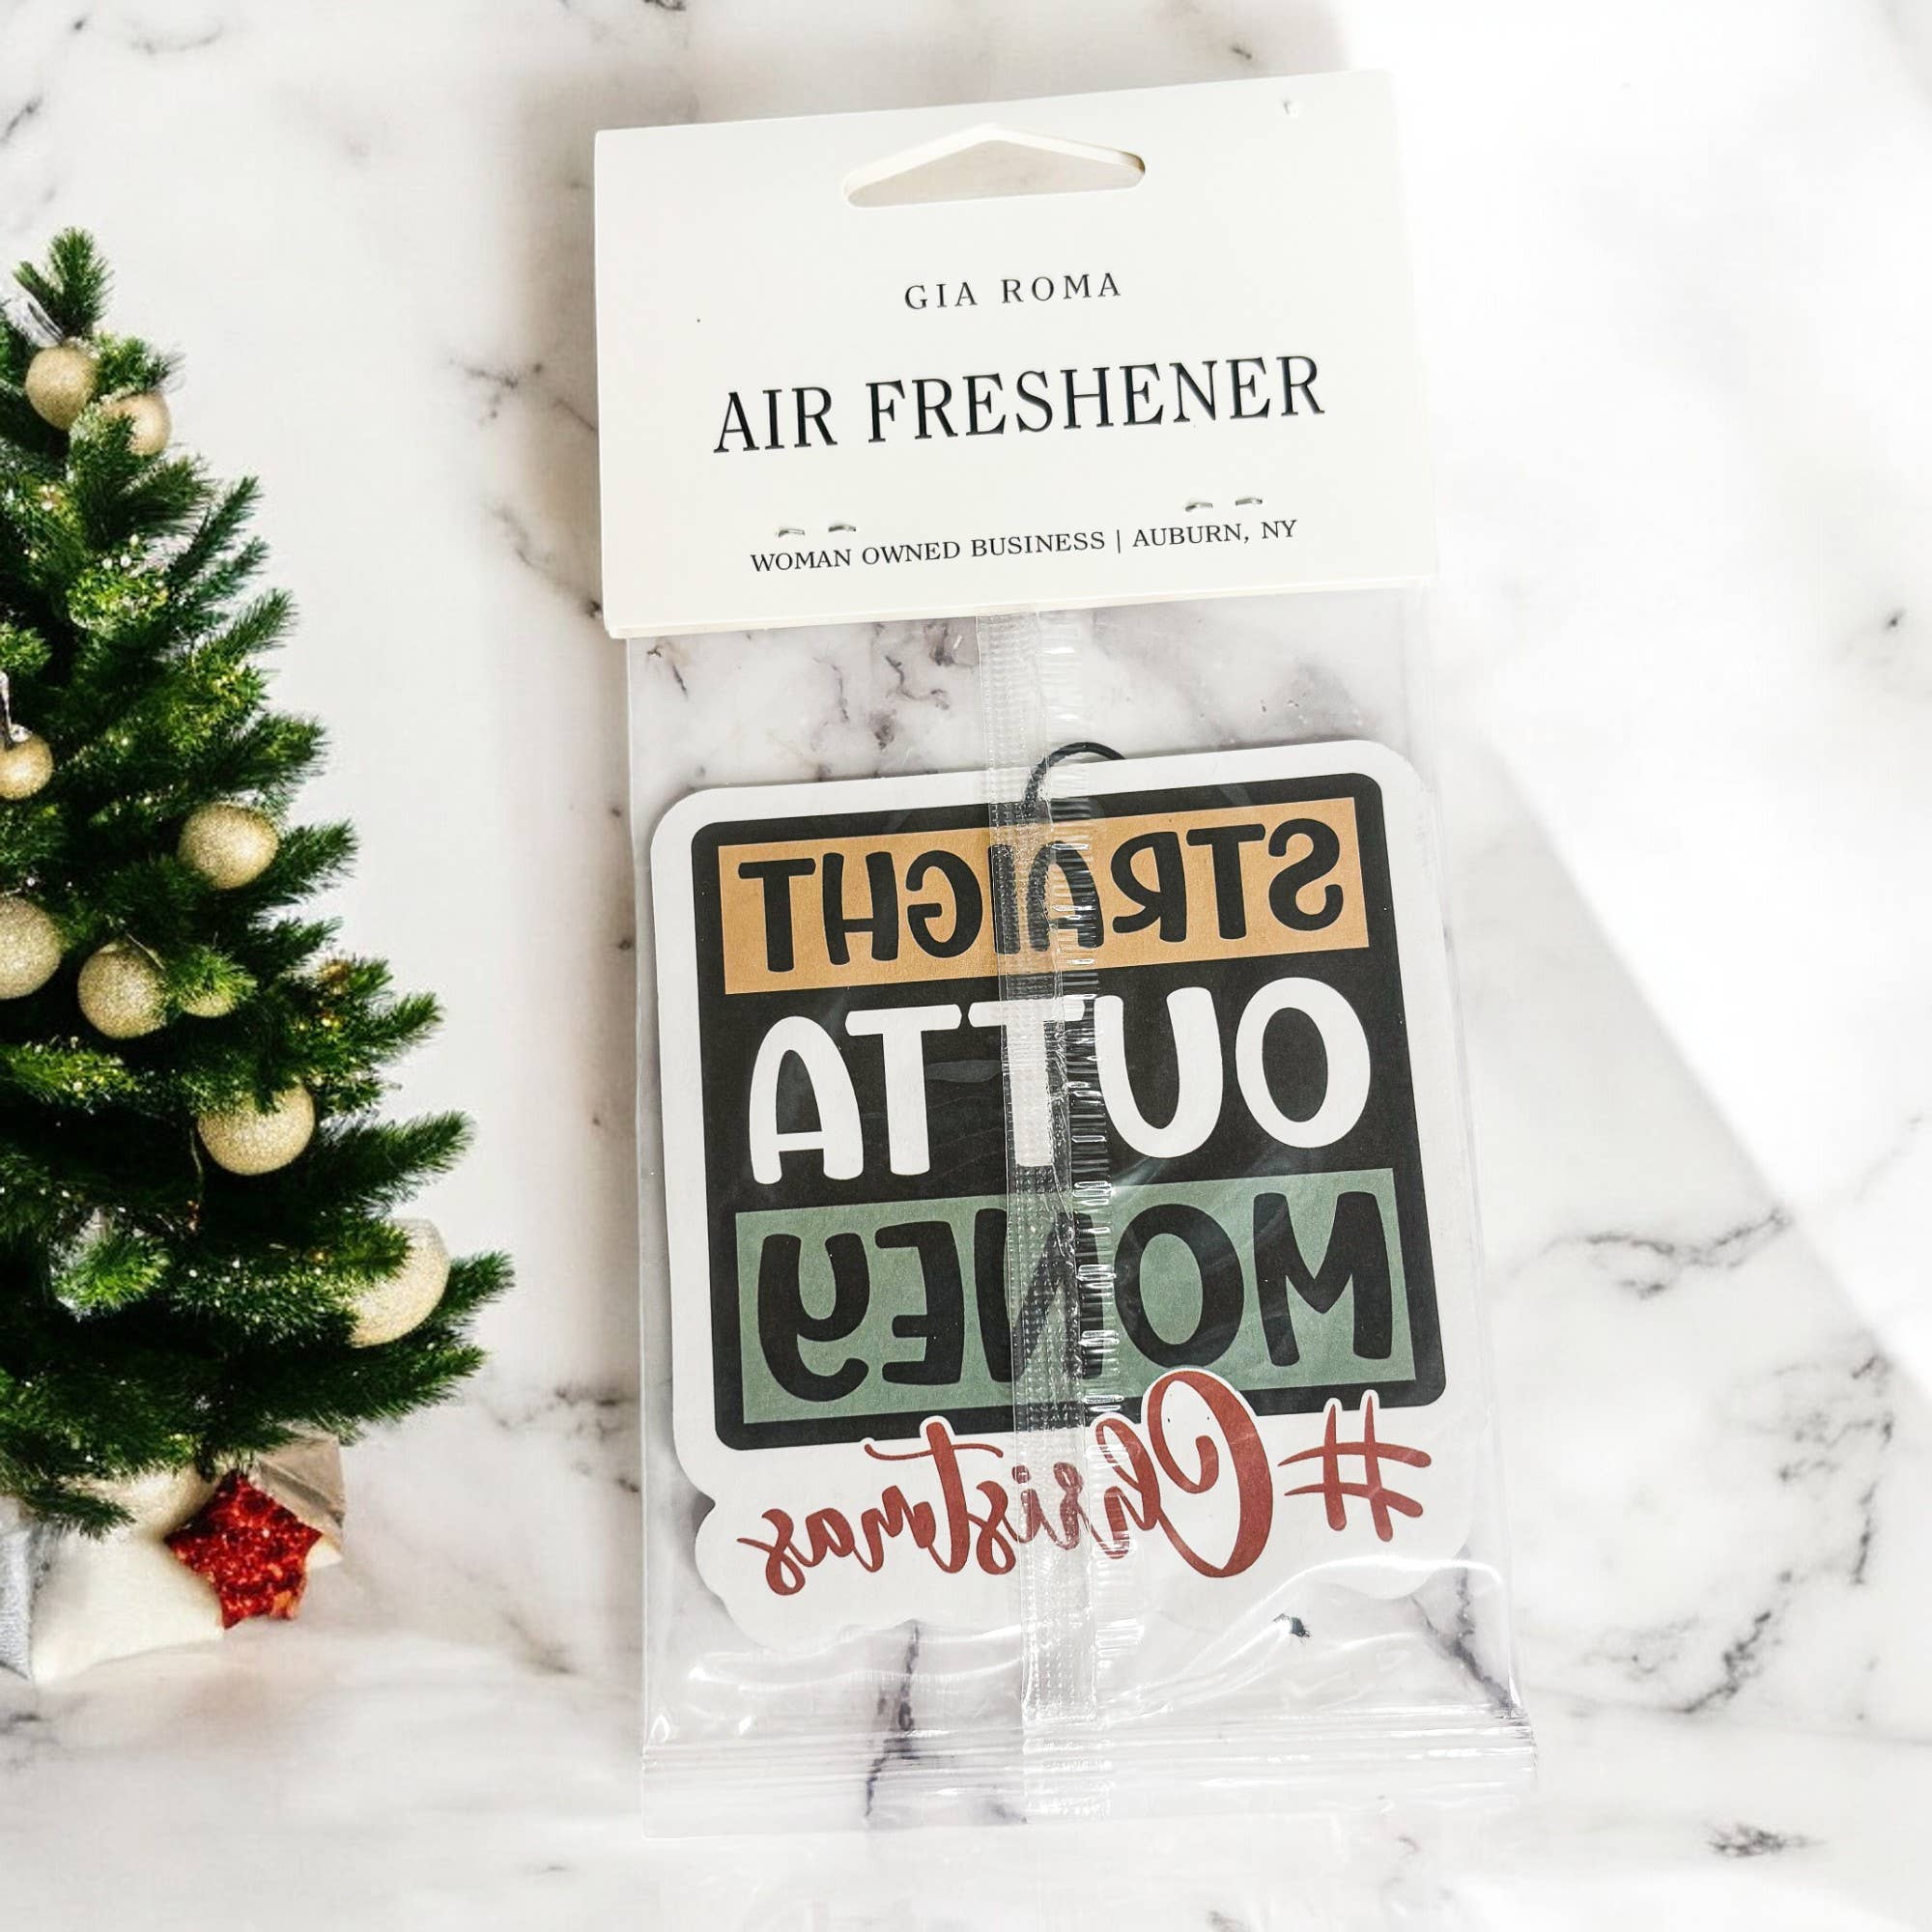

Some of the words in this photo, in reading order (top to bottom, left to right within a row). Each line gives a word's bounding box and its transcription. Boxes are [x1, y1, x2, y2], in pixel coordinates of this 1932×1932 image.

[904, 281, 978, 310] GIA
[1002, 272, 1120, 304] ROMA
[713, 386, 838, 454] AIR
[865, 355, 1325, 443] FRESHENER
[750, 549, 851, 572] WOMAN
[862, 541, 961, 565] OWNED
[971, 531, 1105, 557] BUSINESS
[1132, 523, 1249, 548] AUBURN,
[1262, 519, 1297, 539] NY
